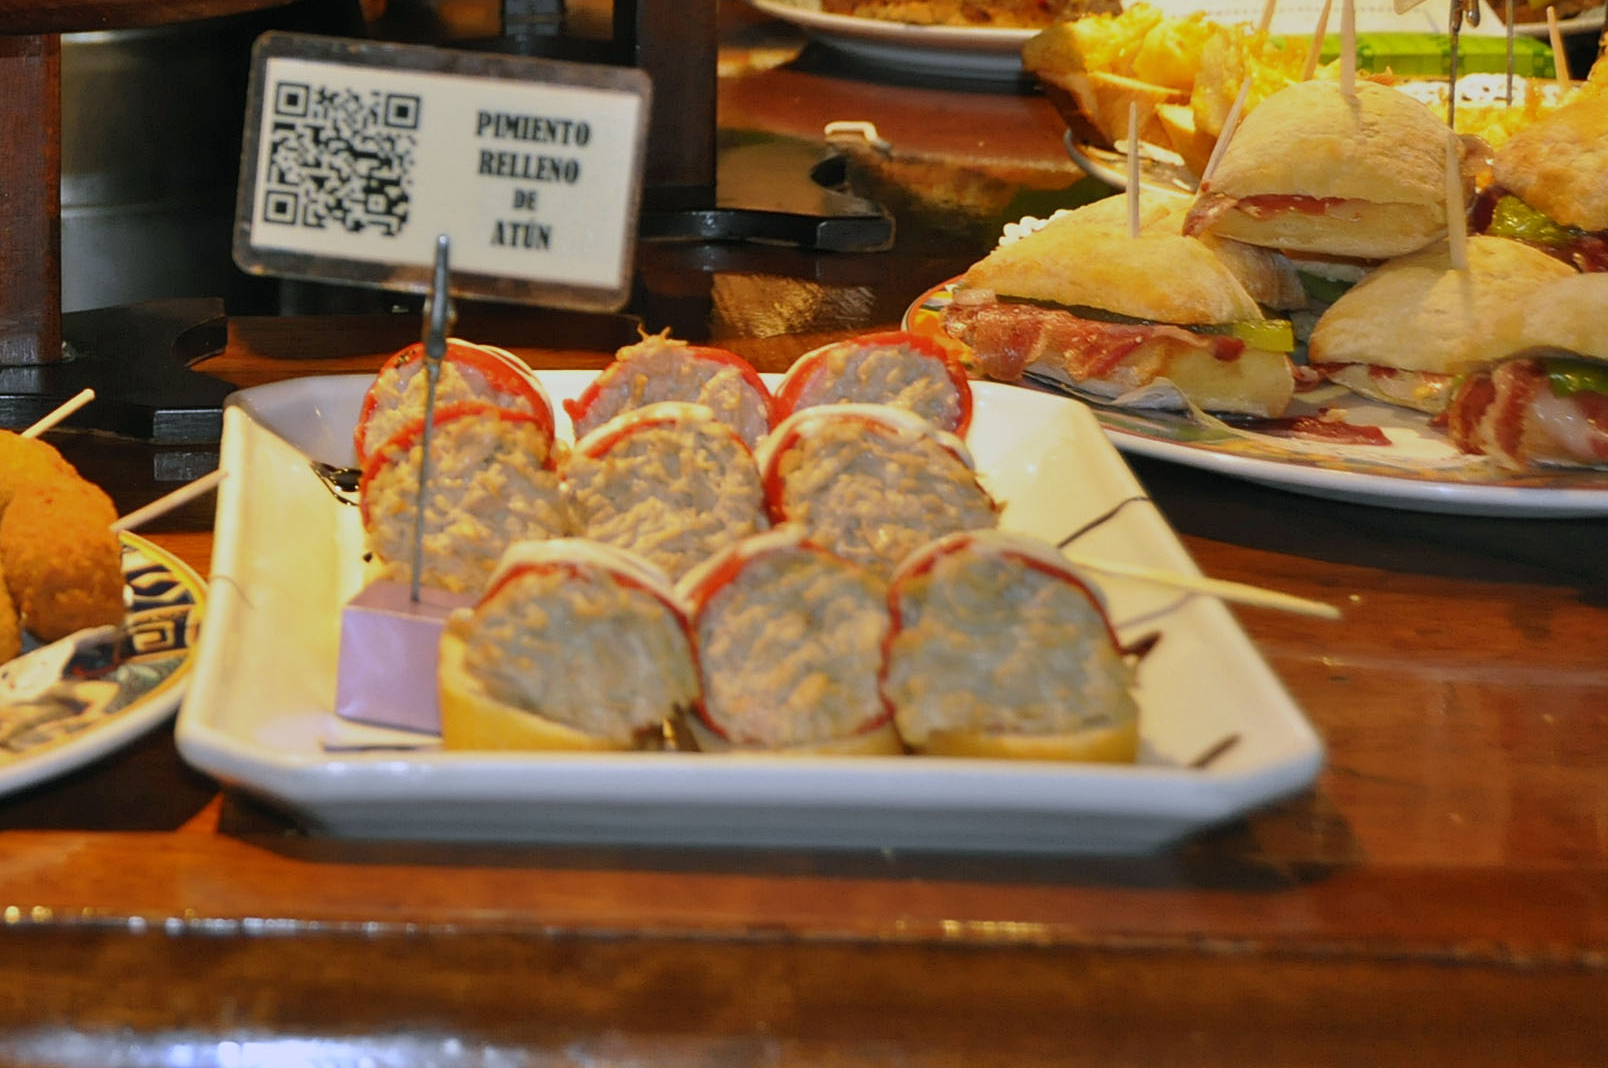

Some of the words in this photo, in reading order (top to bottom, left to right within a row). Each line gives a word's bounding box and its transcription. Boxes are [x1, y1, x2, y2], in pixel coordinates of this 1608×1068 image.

[476, 110, 592, 148] PIMIENTO
[478, 149, 581, 185] RELLENO
[513, 188, 537, 211] DE
[492, 218, 553, 250] ATÚN
